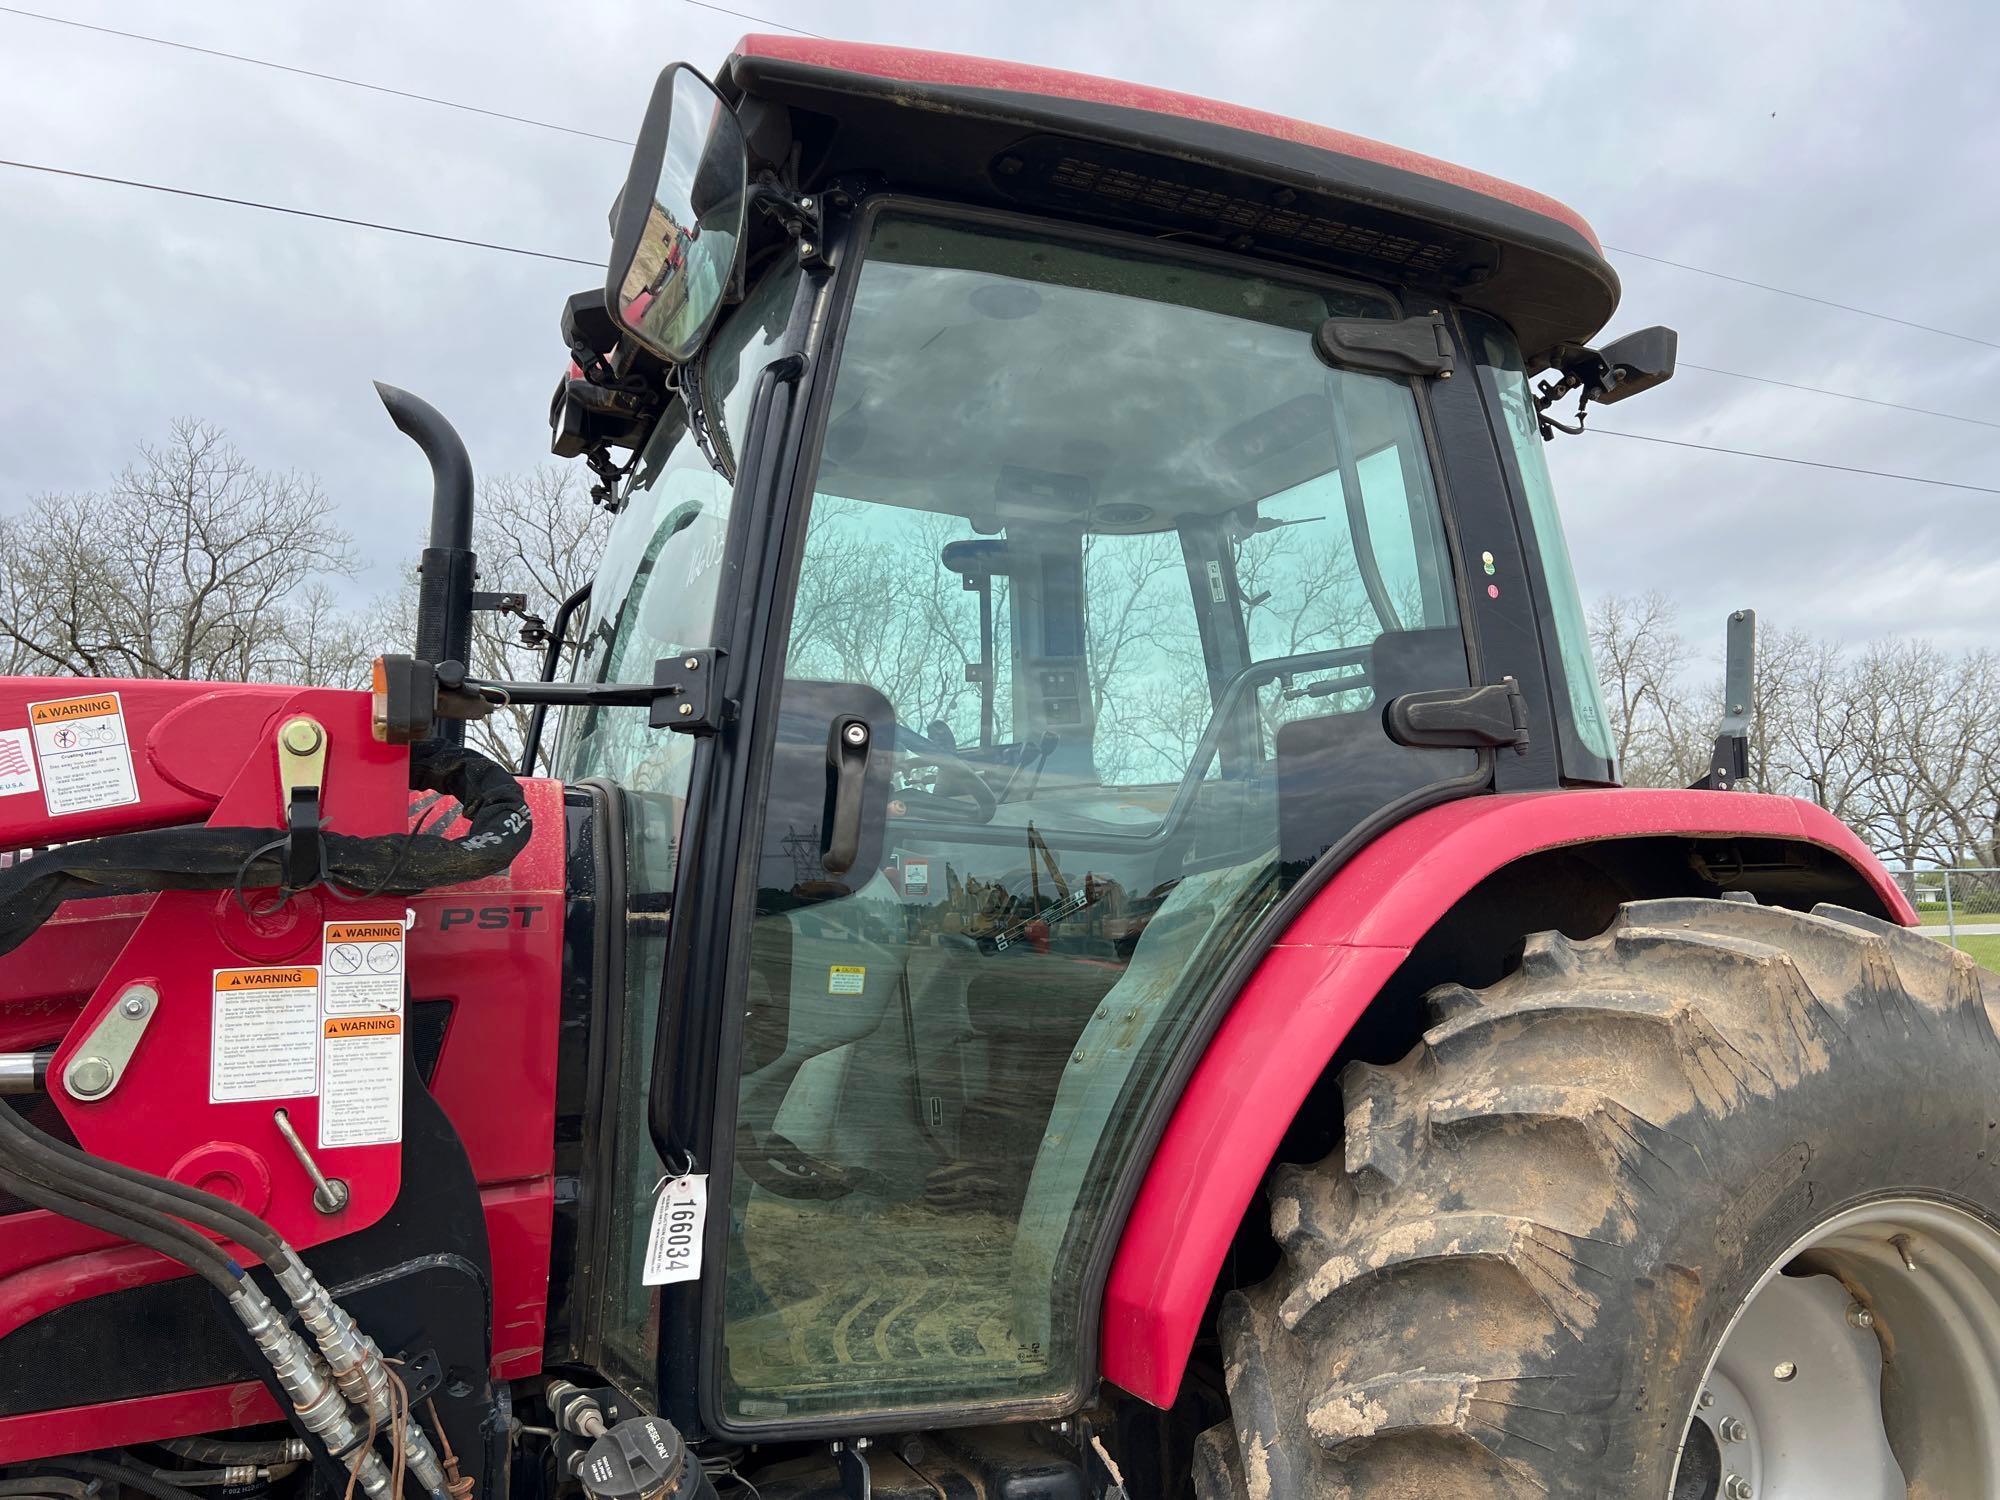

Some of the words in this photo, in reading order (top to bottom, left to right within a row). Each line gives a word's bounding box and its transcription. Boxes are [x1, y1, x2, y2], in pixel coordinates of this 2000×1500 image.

[48, 701, 111, 717] WARNING
[439, 906, 543, 931] PST
[346, 928, 400, 938] WARNING
[244, 973, 302, 984] WARNING
[340, 1020, 395, 1031] WARNING
[665, 1199, 697, 1271] 166034
[645, 1422, 660, 1444] DIESEL
[656, 1442, 670, 1459] ONLY
